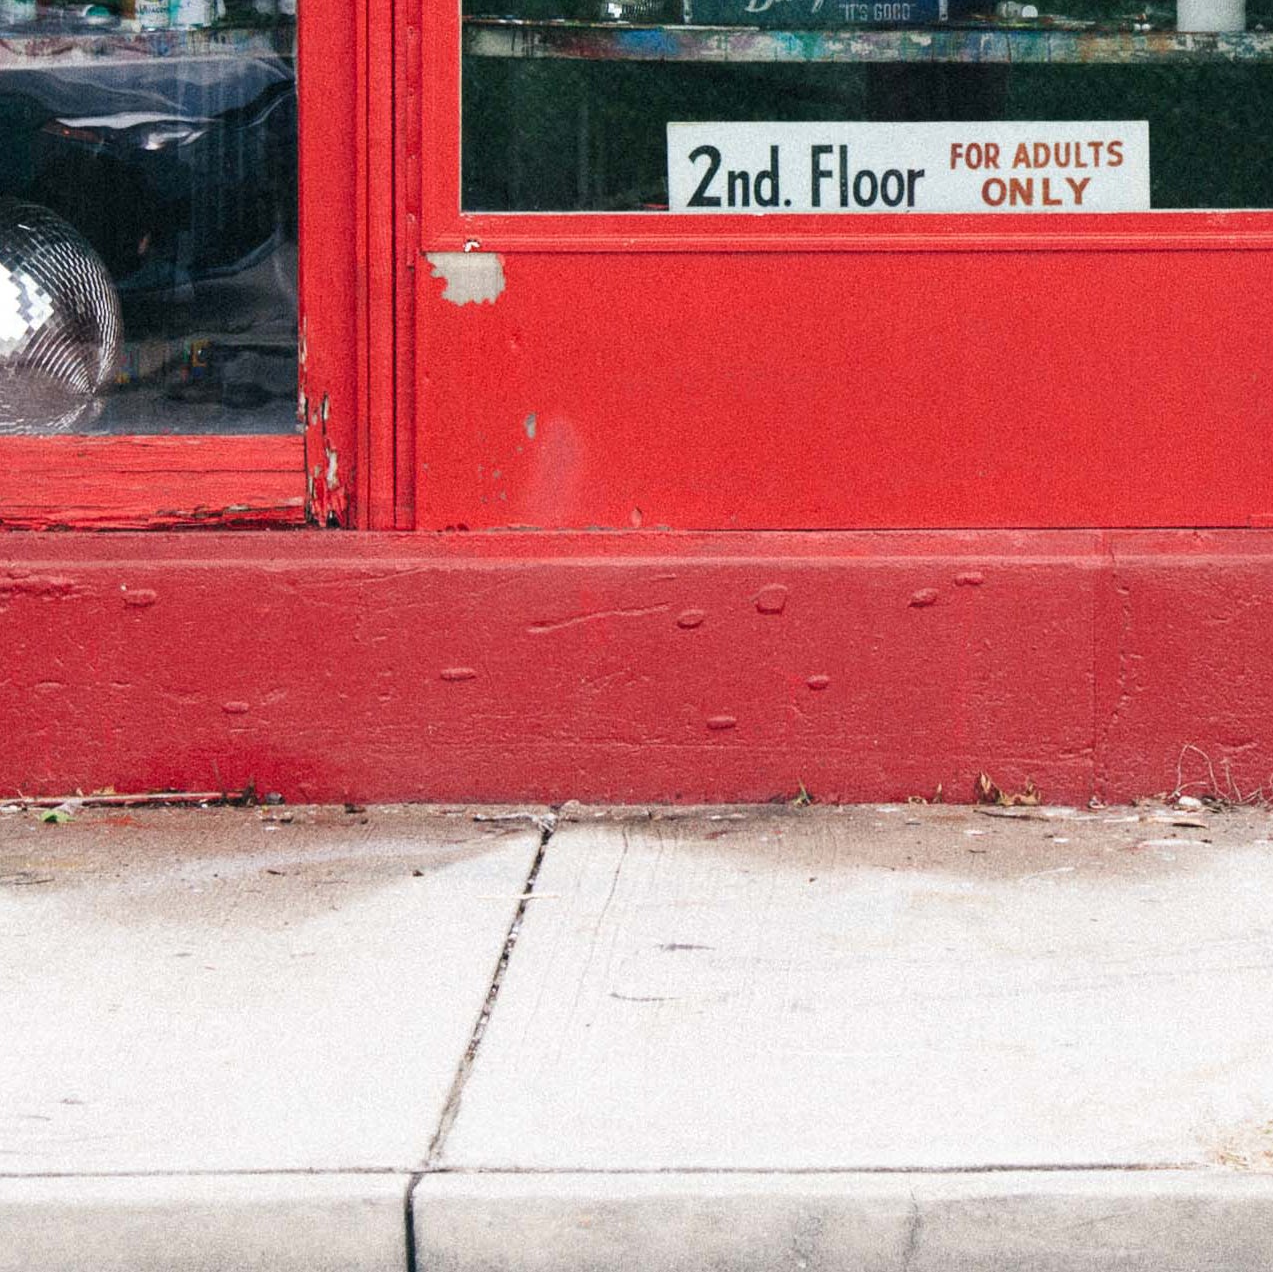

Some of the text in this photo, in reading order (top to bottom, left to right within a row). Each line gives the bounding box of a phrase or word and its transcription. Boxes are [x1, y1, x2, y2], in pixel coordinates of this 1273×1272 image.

[949, 139, 1125, 171] FOR ADULTS
[686, 143, 926, 208] 2nd. Floor
[981, 176, 1092, 207] ONLY
